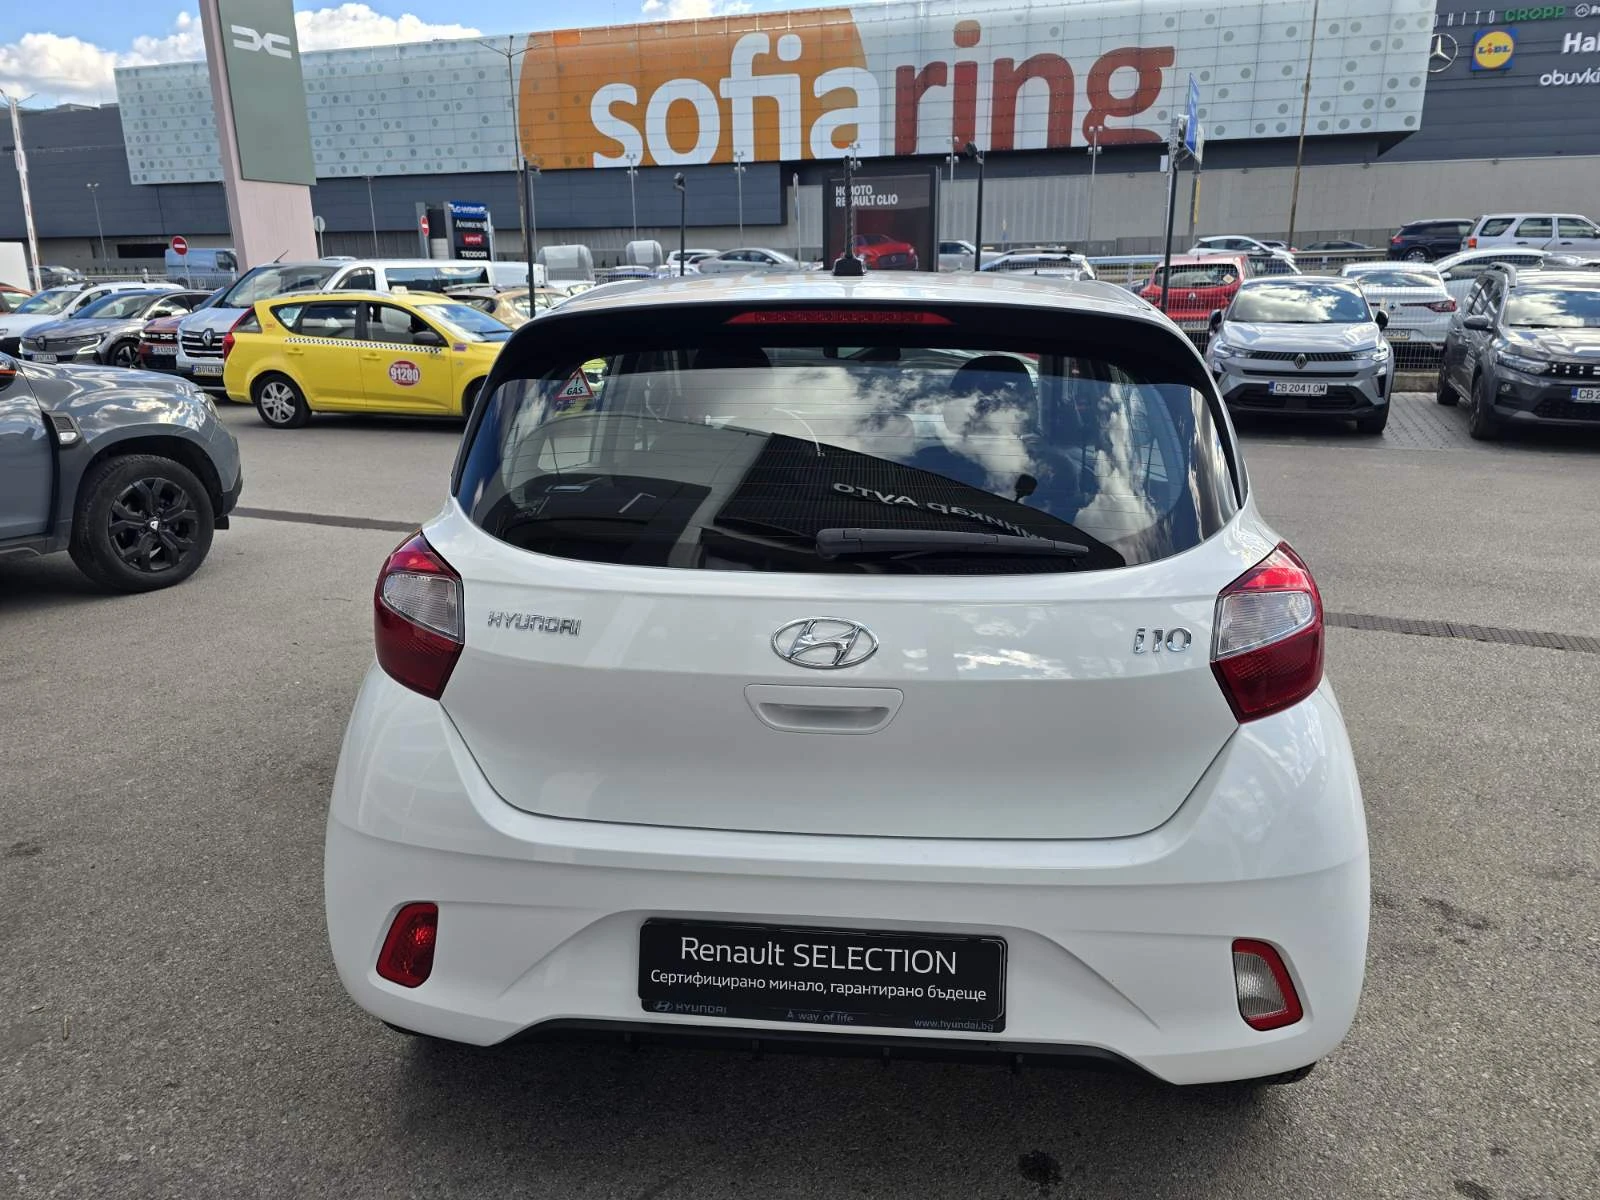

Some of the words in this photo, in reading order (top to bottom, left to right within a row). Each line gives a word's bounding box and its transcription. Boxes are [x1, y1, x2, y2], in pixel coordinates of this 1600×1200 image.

[876, 193, 899, 206] CLIO
[391, 367, 419, 382] 91280
[566, 386, 583, 396] GAS
[487, 610, 582, 636] HYUNDAI
[681, 936, 785, 967] Renault
[793, 943, 957, 975] SELECTION
[650, 968, 766, 990] Сертифицирано
[769, 978, 828, 994] минало,
[830, 983, 924, 999] гарантирано
[927, 984, 987, 1003] бъдеще
[675, 1001, 727, 1015] HYUNDAI
[799, 1012, 820, 1022] way
[823, 1011, 834, 1021] of
[836, 1012, 854, 1023] life
[914, 1020, 994, 1032] www.hyundai.bg
